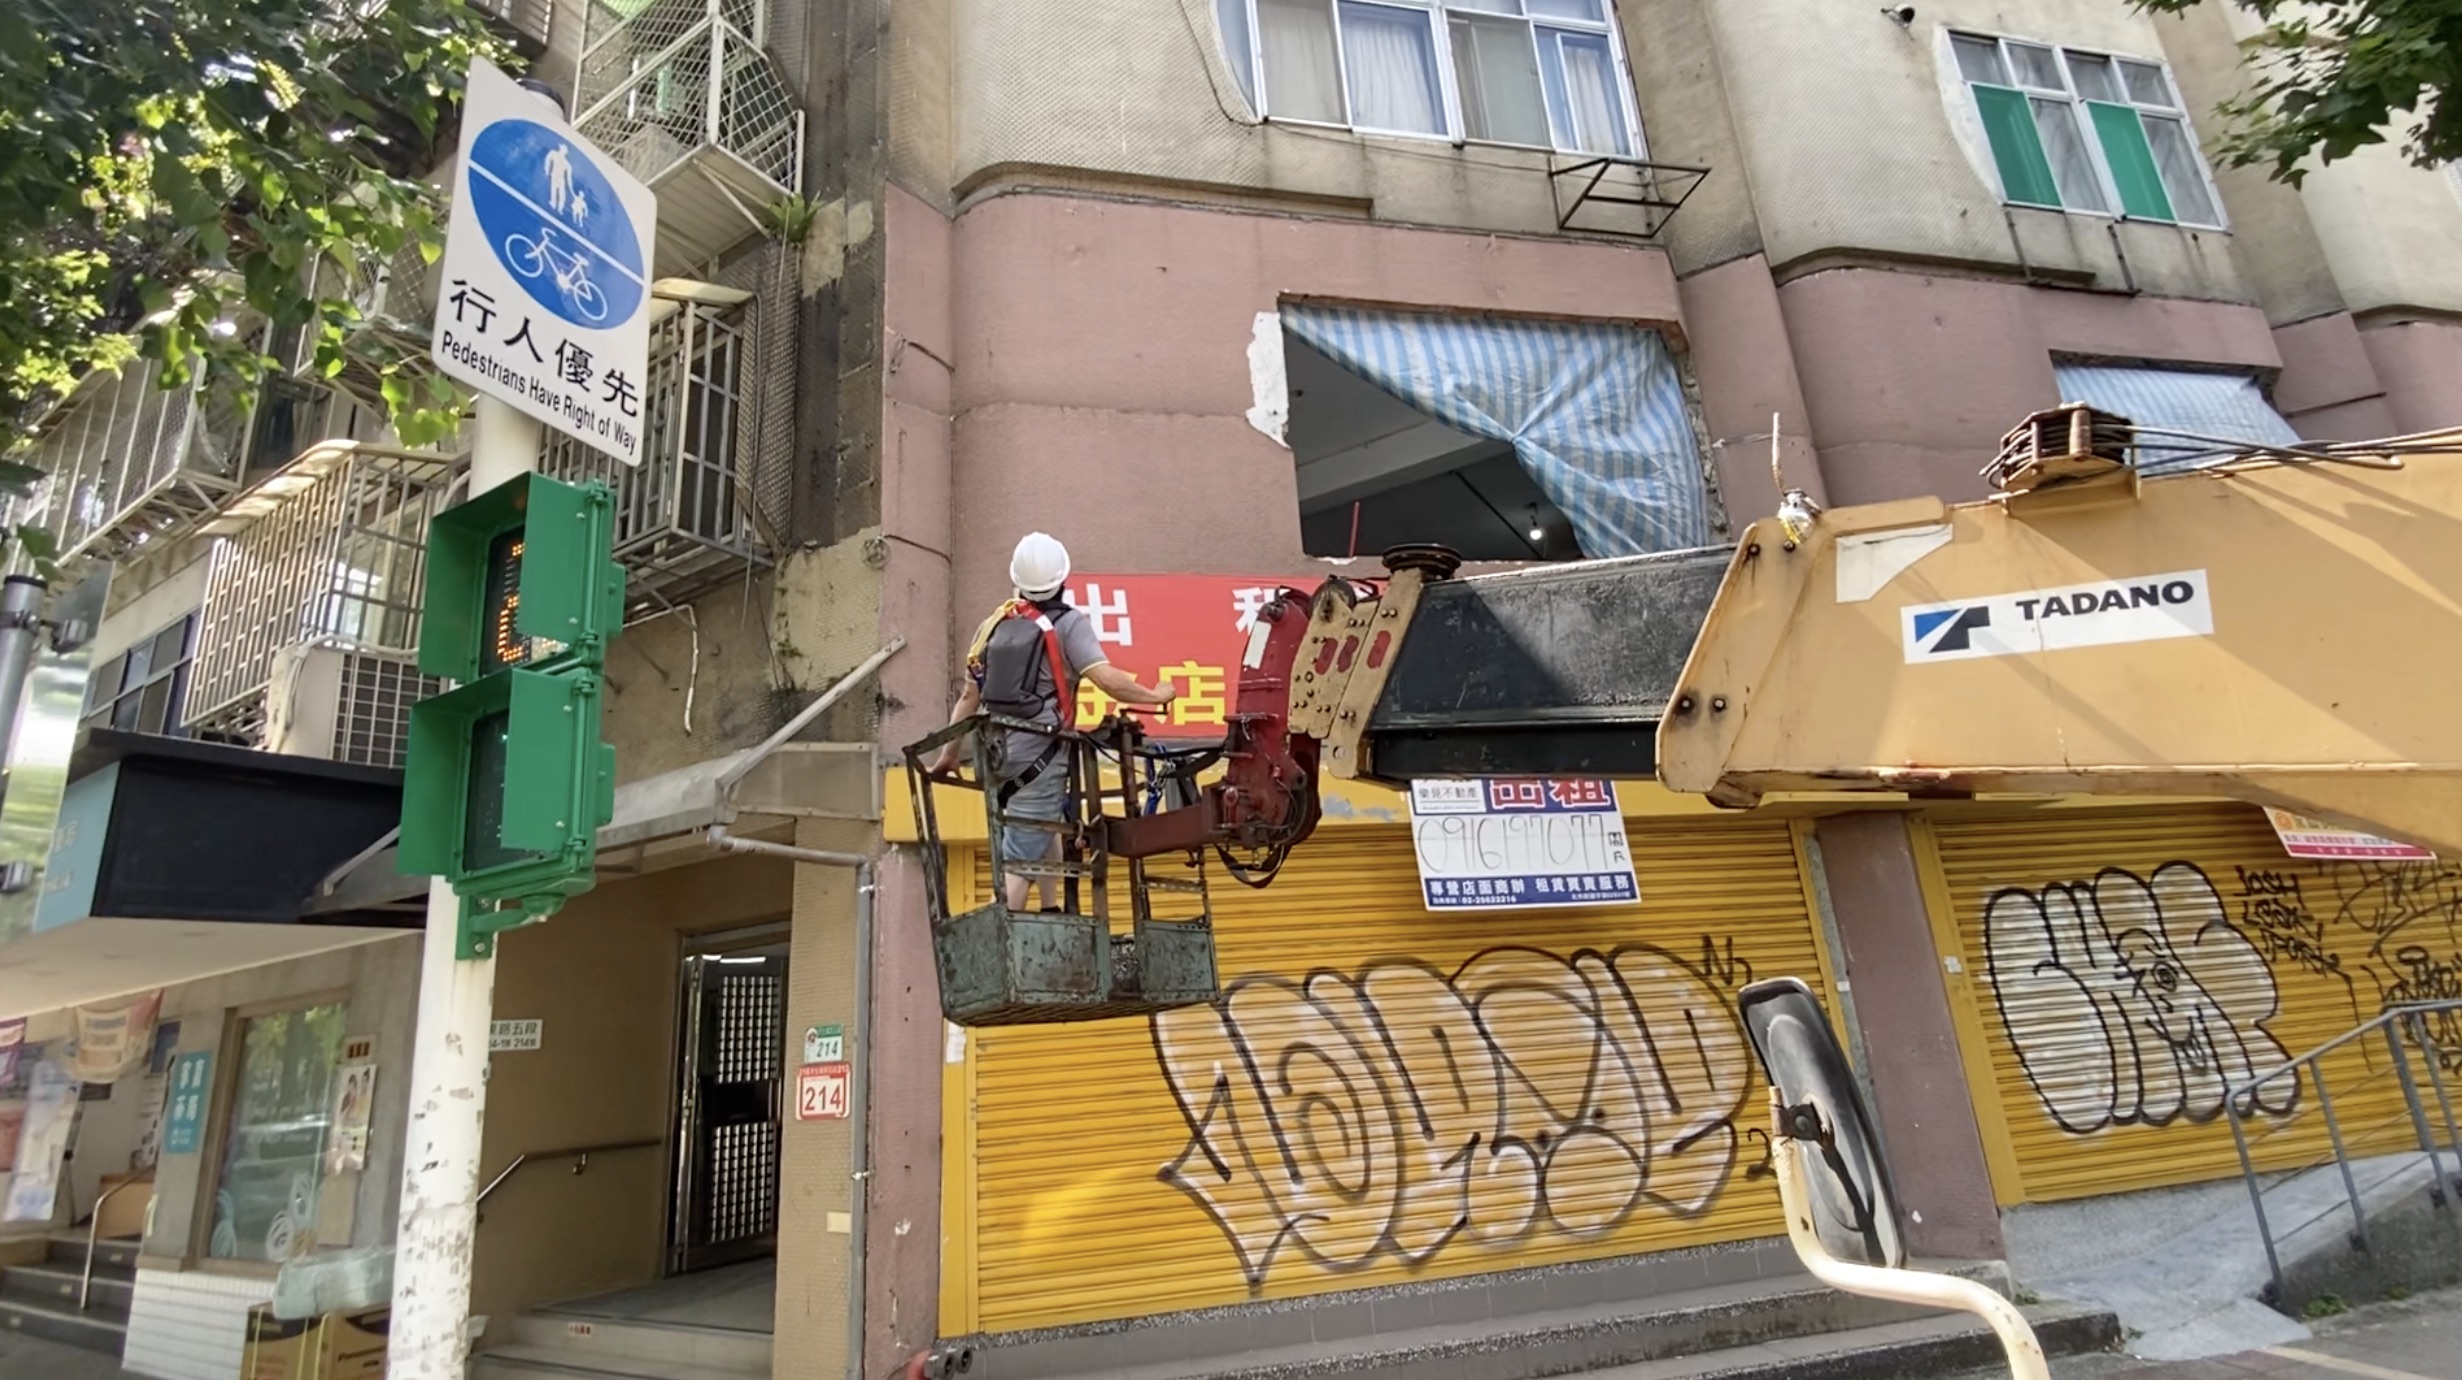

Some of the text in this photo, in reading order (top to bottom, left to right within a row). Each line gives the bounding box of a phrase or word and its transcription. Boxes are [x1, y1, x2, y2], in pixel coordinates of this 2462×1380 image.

[449, 279, 638, 418] 行人優先
[442, 330, 637, 456] Pedestrians Have Right of Way
[2015, 580, 2194, 620] TADANO
[817, 1040, 838, 1057] 214
[804, 1084, 841, 1110] 214
